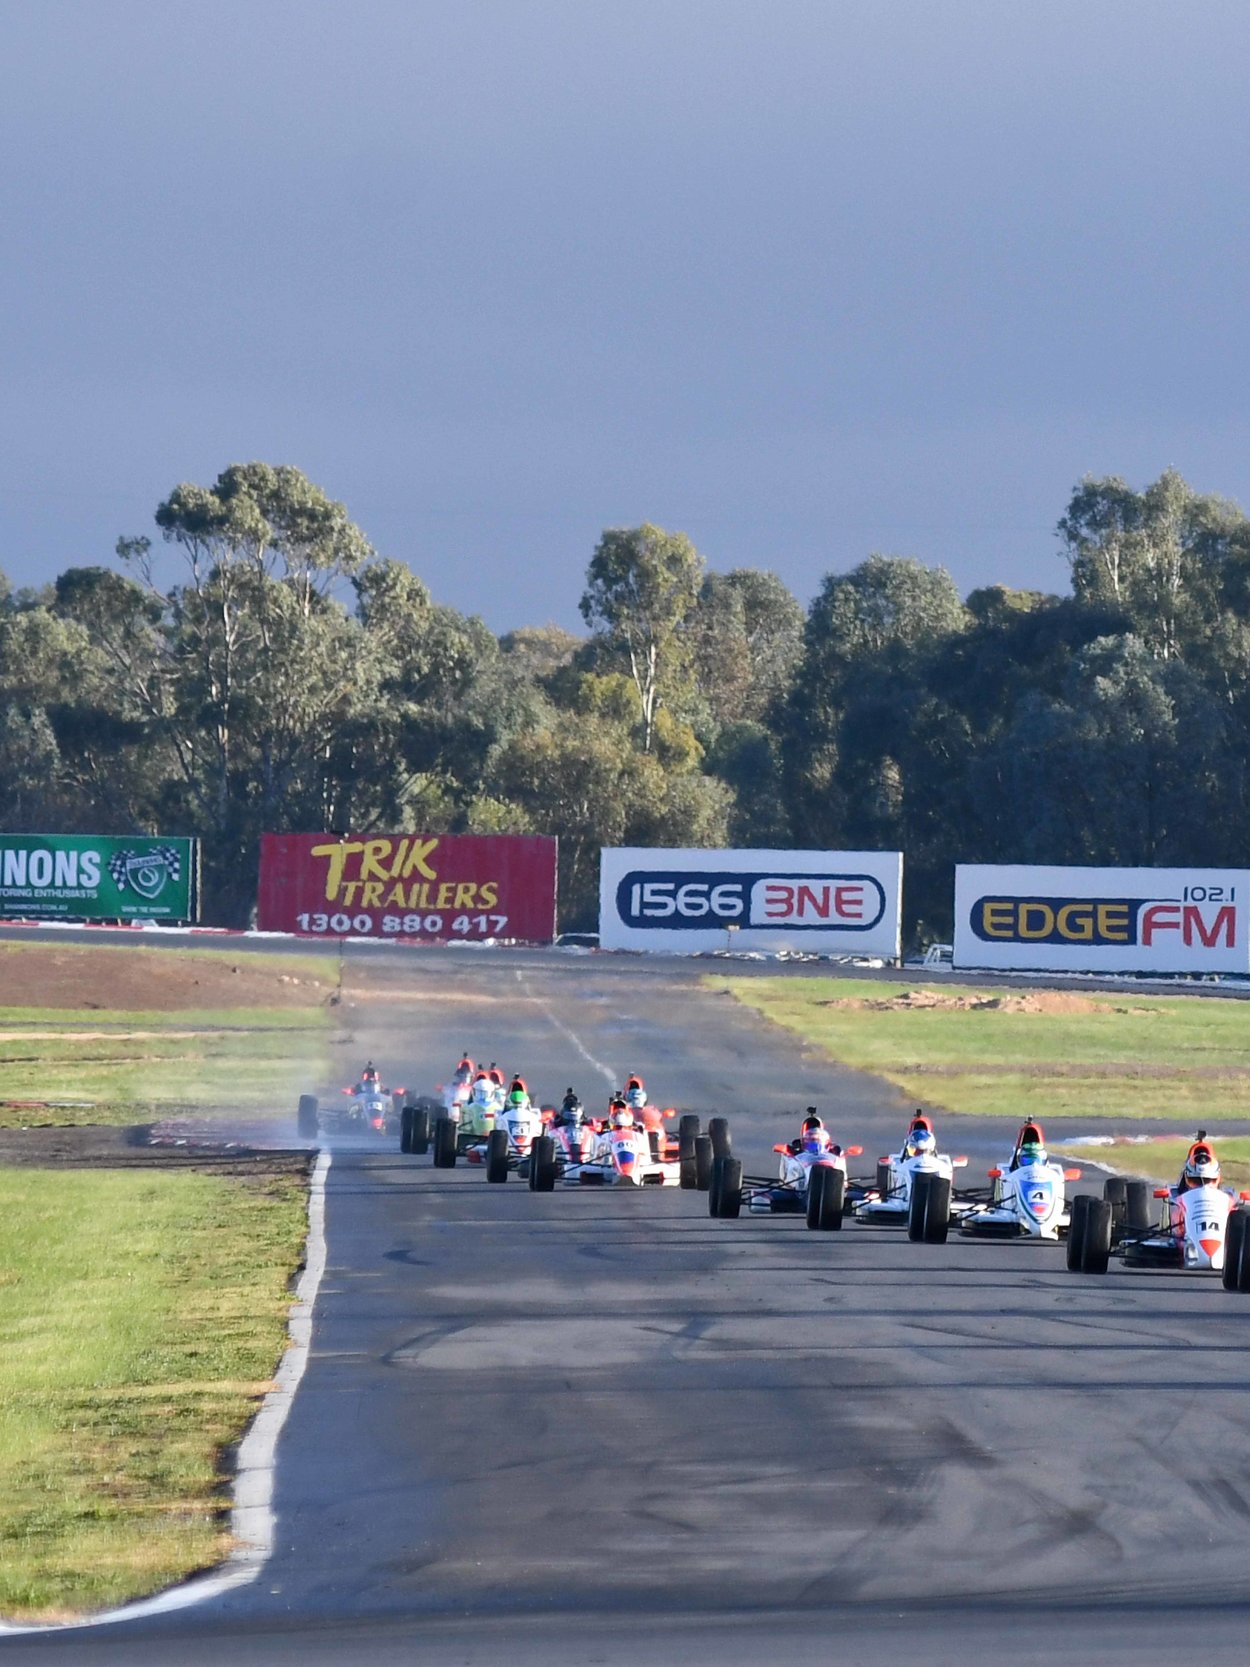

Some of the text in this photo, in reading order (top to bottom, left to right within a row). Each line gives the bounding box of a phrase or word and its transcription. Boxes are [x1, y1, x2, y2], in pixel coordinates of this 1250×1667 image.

[0, 849, 100, 888] NONS
[311, 838, 439, 901] TRIK
[34, 888, 98, 899] ENTHUSIASTS
[341, 881, 499, 910] TRAILERS
[630, 883, 864, 918] 1566 3NE
[1183, 886, 1235, 902] 102.1
[296, 913, 509, 935] 1300 880 417
[982, 903, 1236, 948] EDGE FM
[1032, 1191, 1044, 1201] 4
[1201, 1221, 1220, 1232] 14
